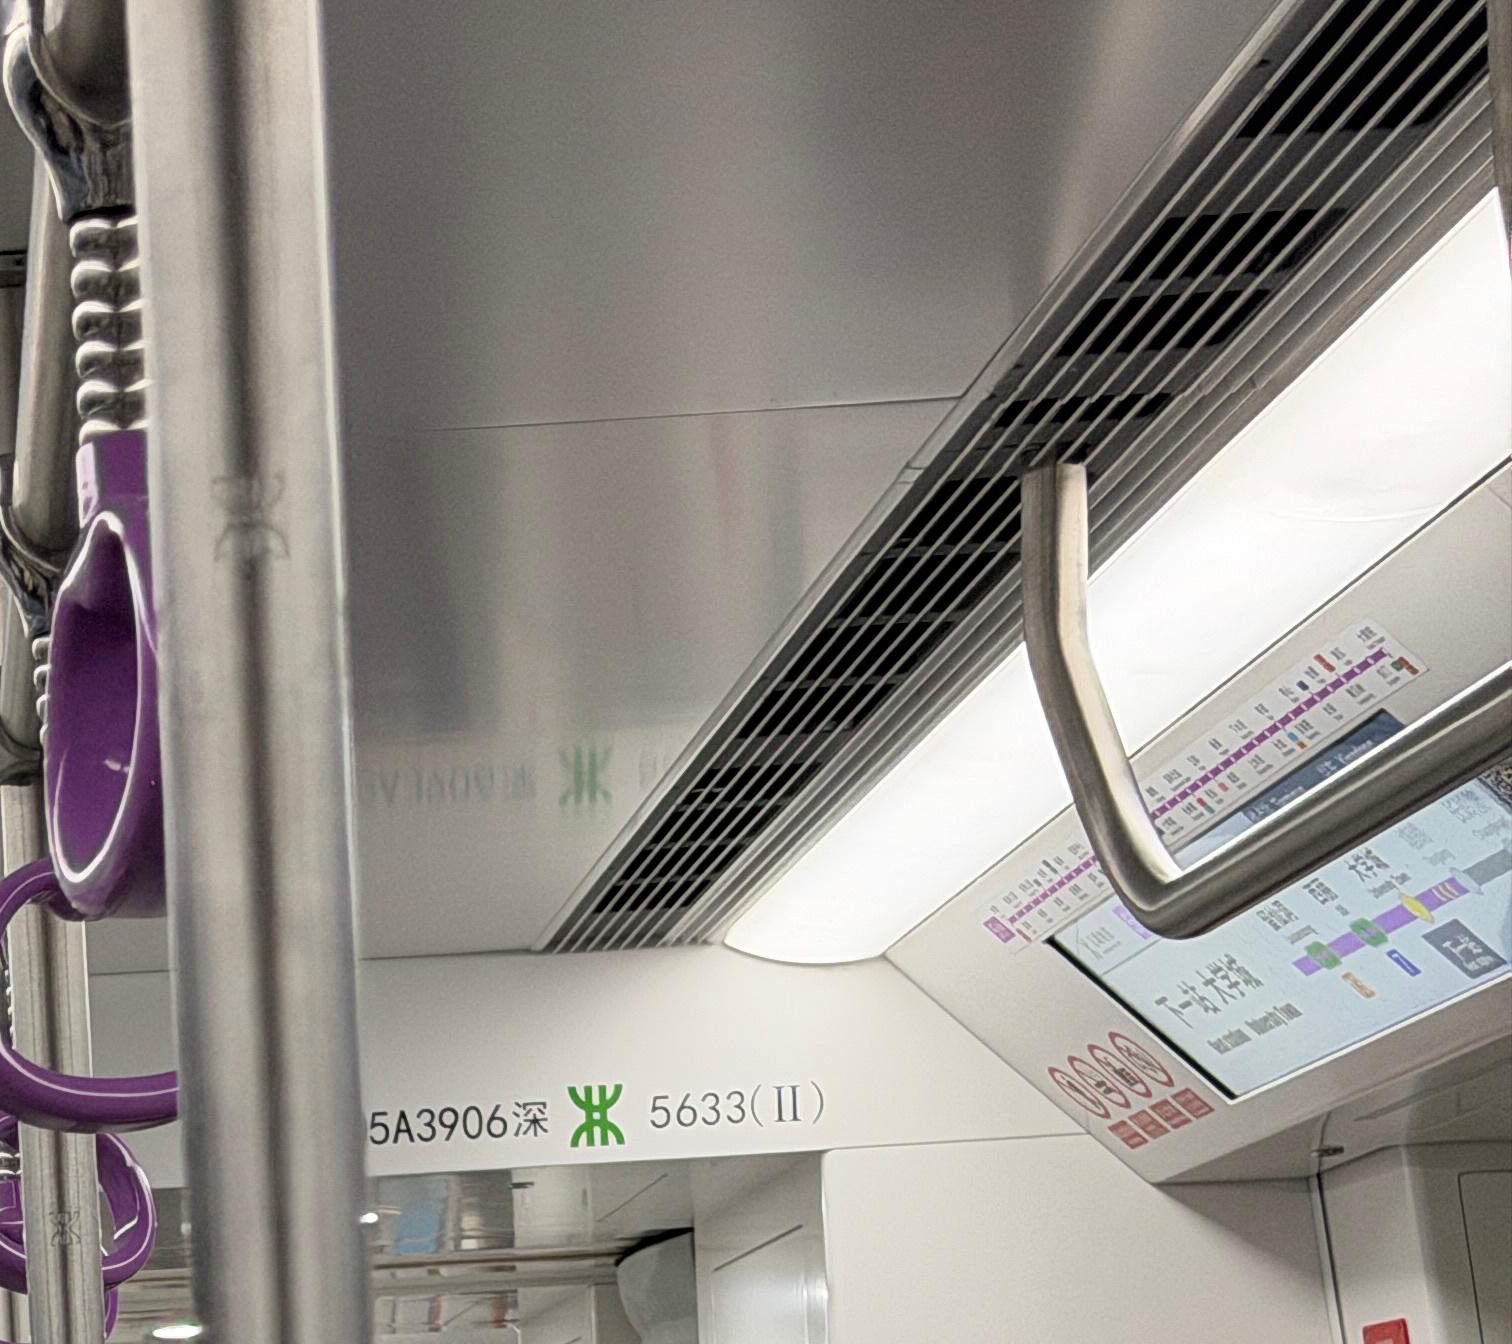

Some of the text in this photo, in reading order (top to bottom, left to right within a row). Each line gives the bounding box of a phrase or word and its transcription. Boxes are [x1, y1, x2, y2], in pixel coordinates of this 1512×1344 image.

[1154, 953, 1265, 1030] 下一站 大学城
